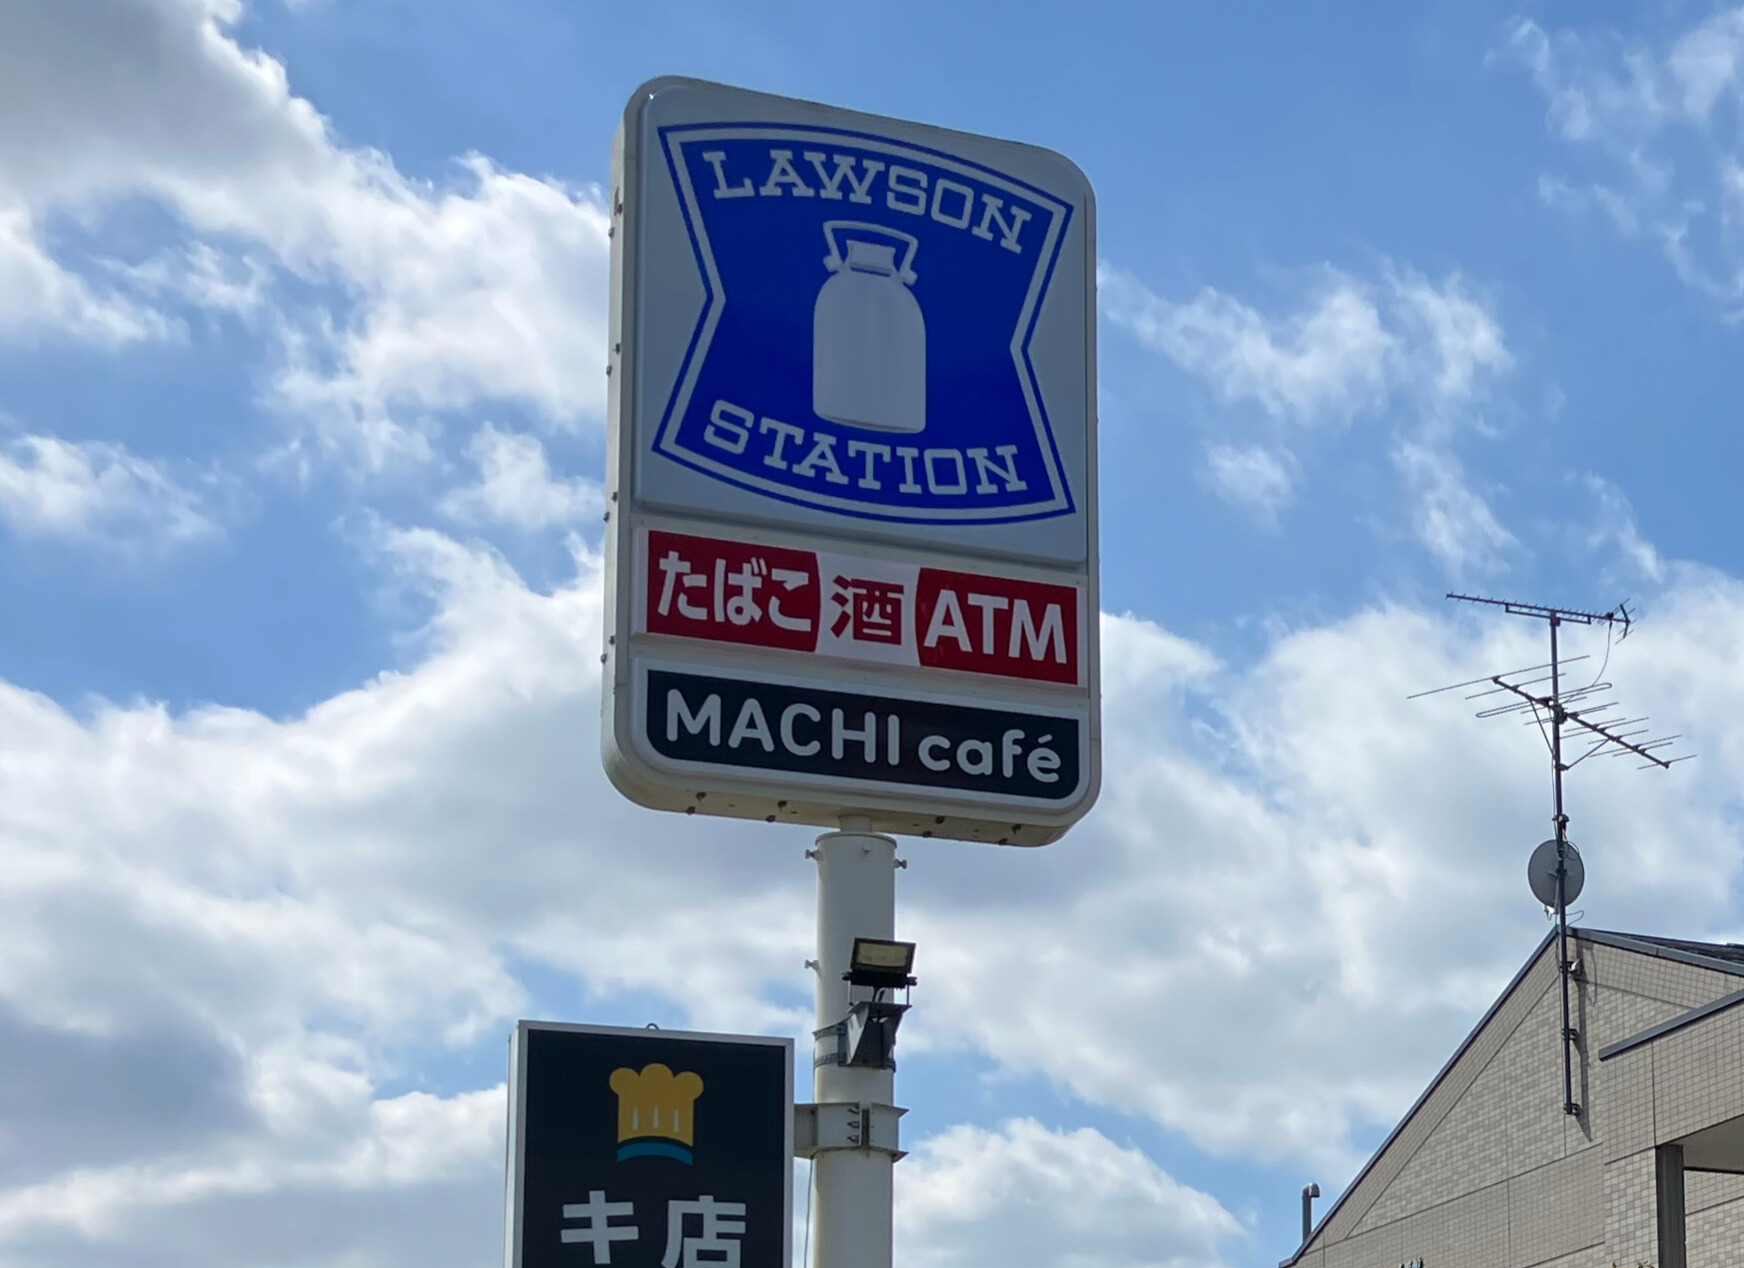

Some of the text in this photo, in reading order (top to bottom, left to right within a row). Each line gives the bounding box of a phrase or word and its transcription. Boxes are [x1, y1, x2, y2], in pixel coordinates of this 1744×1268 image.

[702, 149, 1032, 254] LAWSON
[704, 399, 1028, 495] STATION
[658, 550, 1068, 665] たばこ 酒 ATM
[666, 688, 1062, 784] MACHI café
